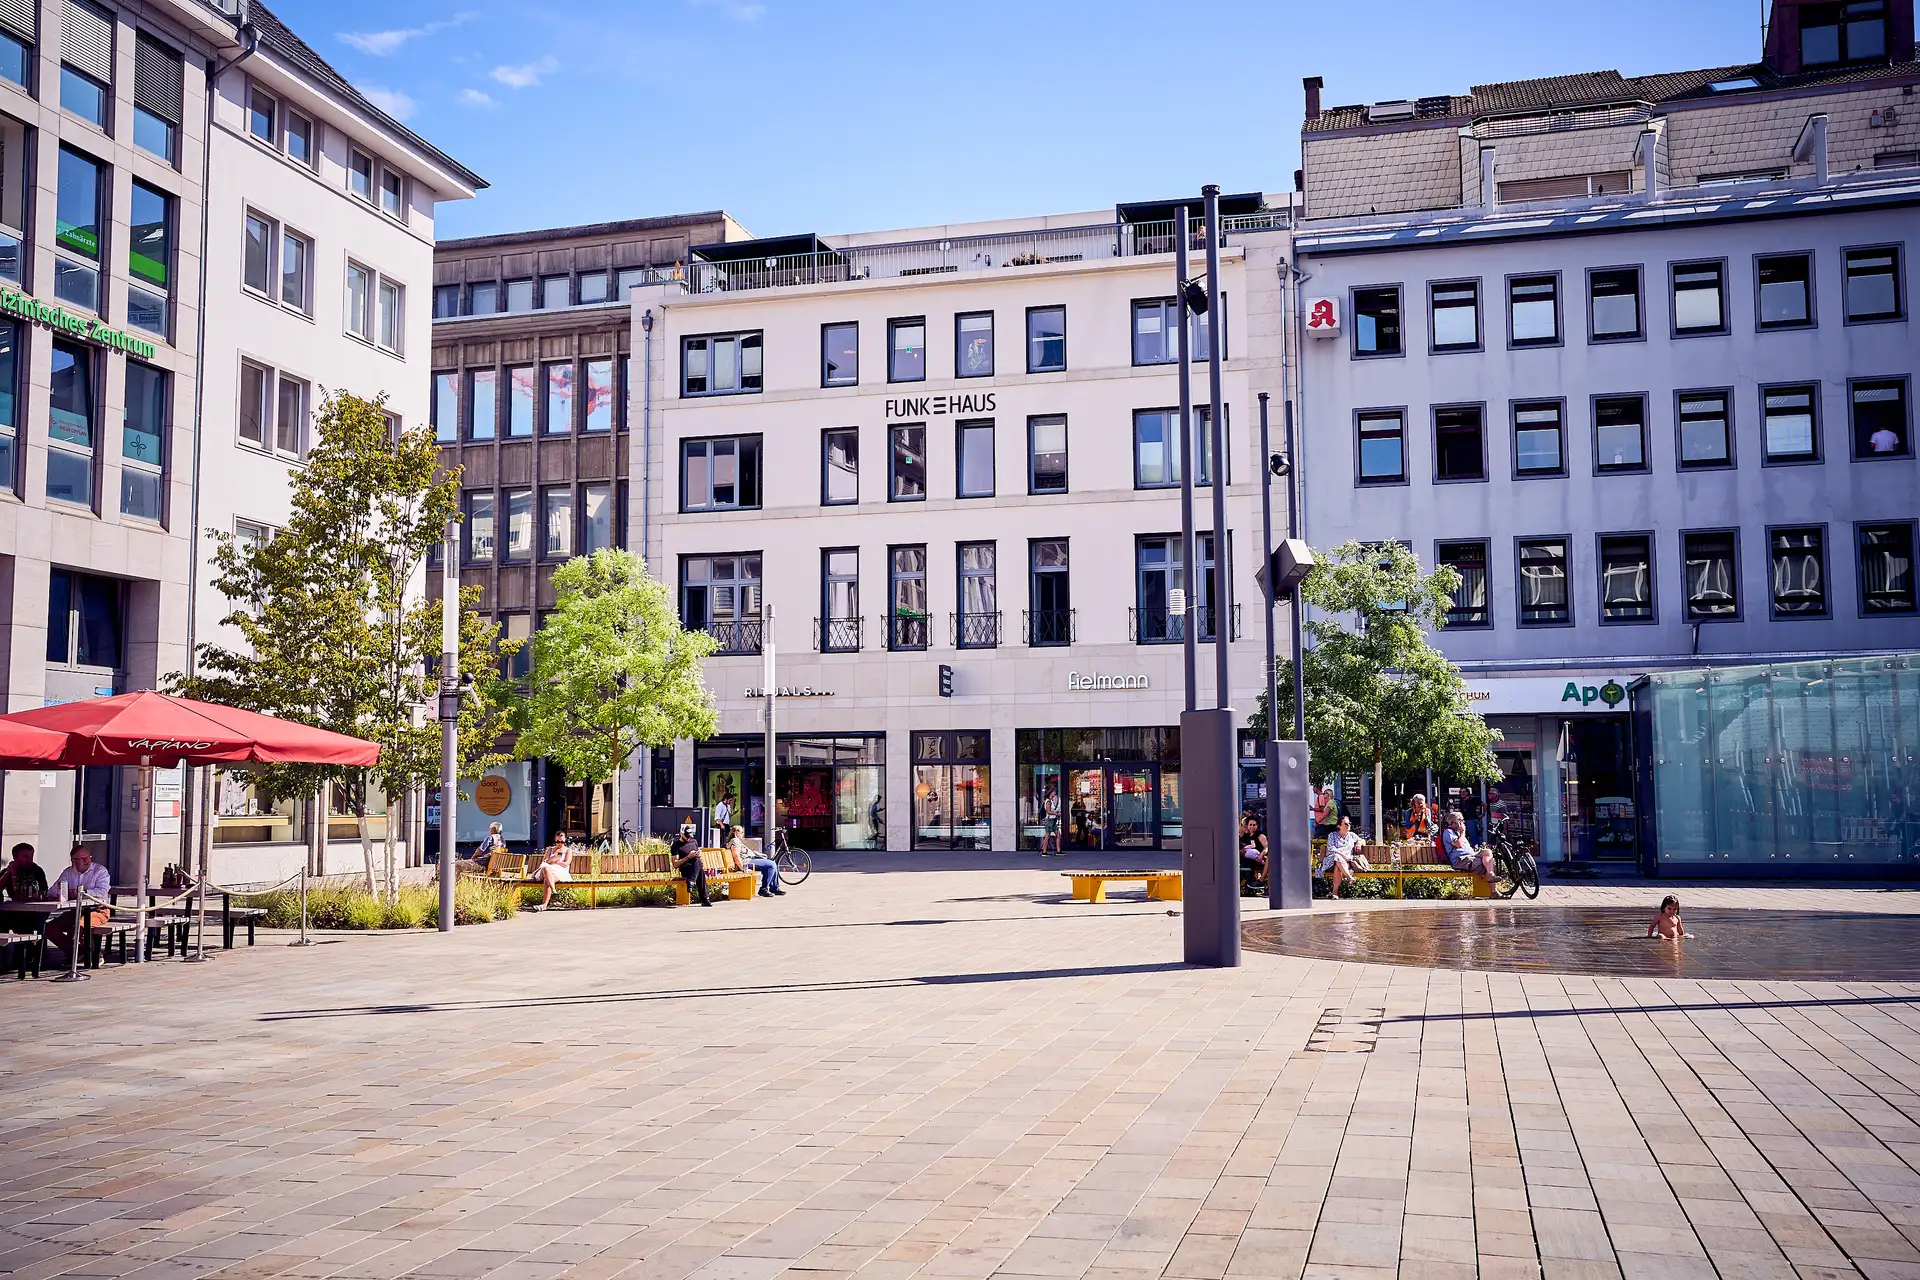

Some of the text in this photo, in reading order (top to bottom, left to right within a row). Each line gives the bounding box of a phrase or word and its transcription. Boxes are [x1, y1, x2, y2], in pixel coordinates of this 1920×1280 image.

[91, 319, 156, 359] Zentrum
[1068, 671, 1149, 690] fielmann
[493, 786, 504, 795] bye
